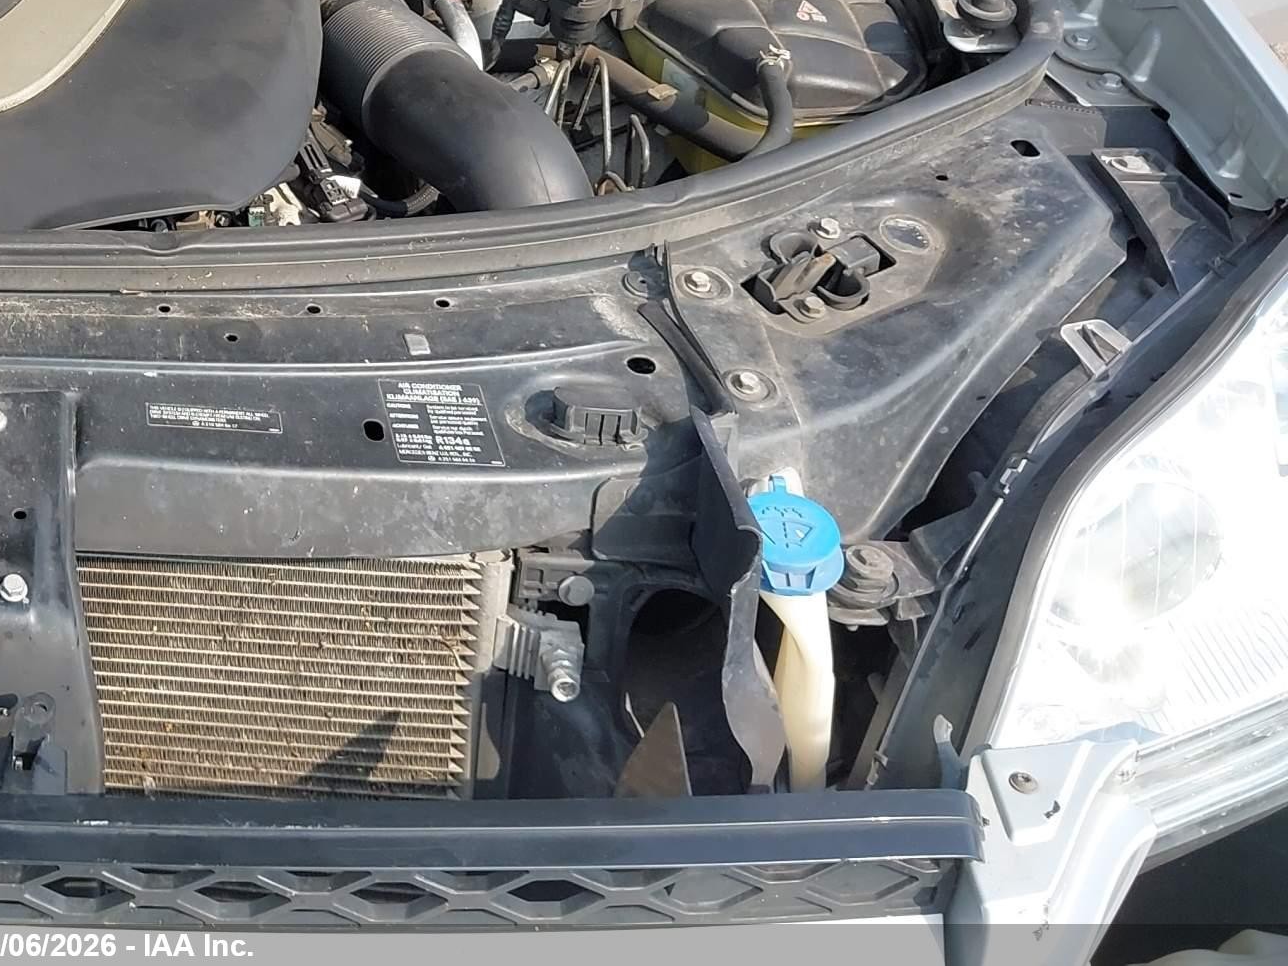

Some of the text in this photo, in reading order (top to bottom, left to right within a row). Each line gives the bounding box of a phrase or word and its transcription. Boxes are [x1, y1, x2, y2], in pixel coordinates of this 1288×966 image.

[411, 382, 463, 392] CONDITIONER
[403, 388, 460, 397] CLIMATISATION
[386, 393, 439, 403] KLIMAANLAGE
[435, 435, 471, 446] R134a
